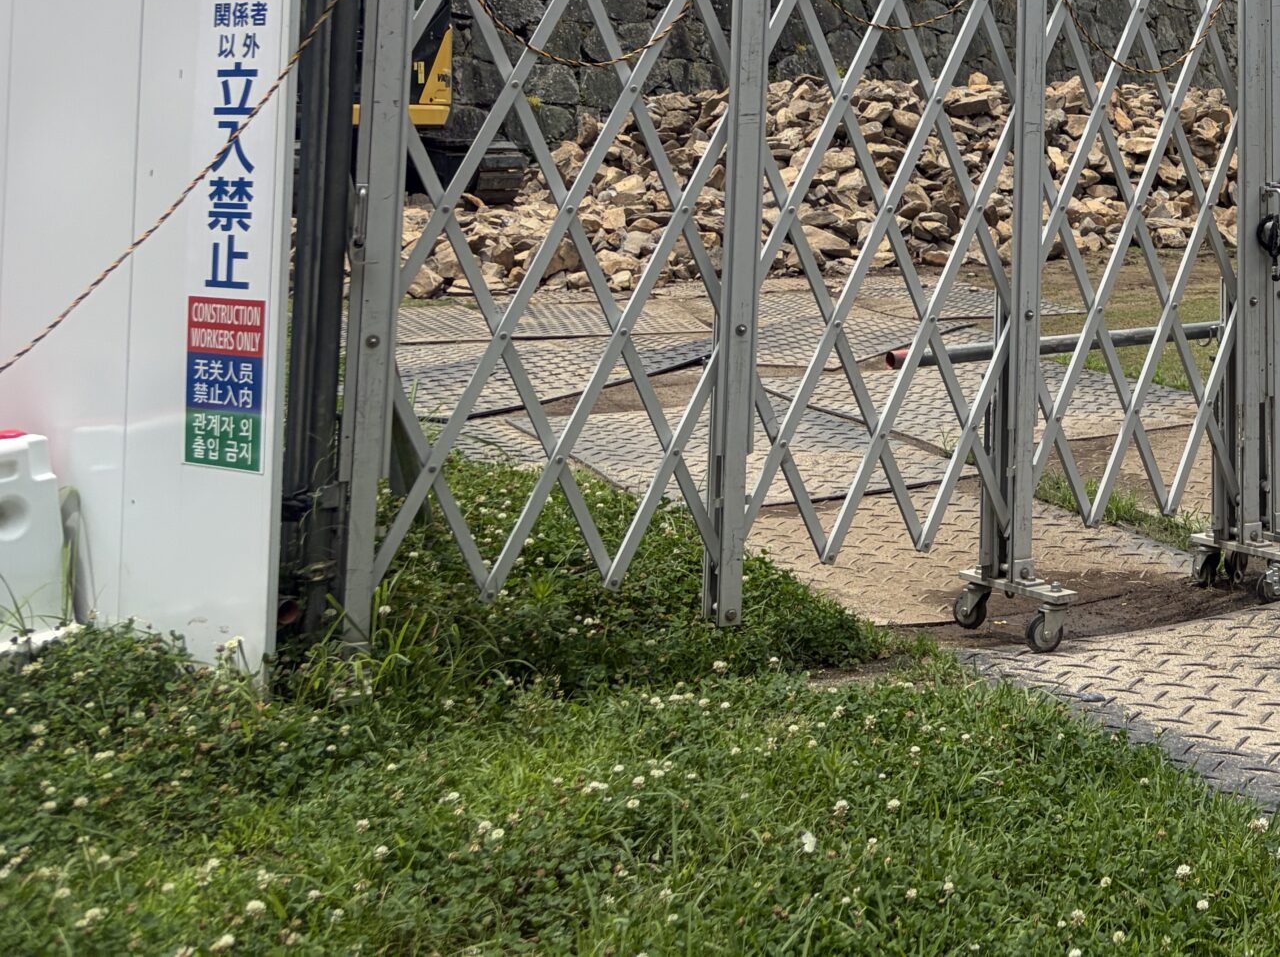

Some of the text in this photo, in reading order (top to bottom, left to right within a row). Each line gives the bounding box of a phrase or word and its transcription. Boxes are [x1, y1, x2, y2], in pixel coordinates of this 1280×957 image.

[213, 1, 268, 27] 関係者
[218, 33, 260, 58] 以外
[205, 62, 258, 289] 立入禁止
[192, 302, 261, 326] CONSTRUCTION
[191, 327, 261, 352] WORKERS ONLY
[193, 359, 254, 383] 无关人员
[193, 383, 253, 408] 禁止入内
[192, 413, 253, 441] 관계자 외
[192, 435, 252, 465] 출입 금지
